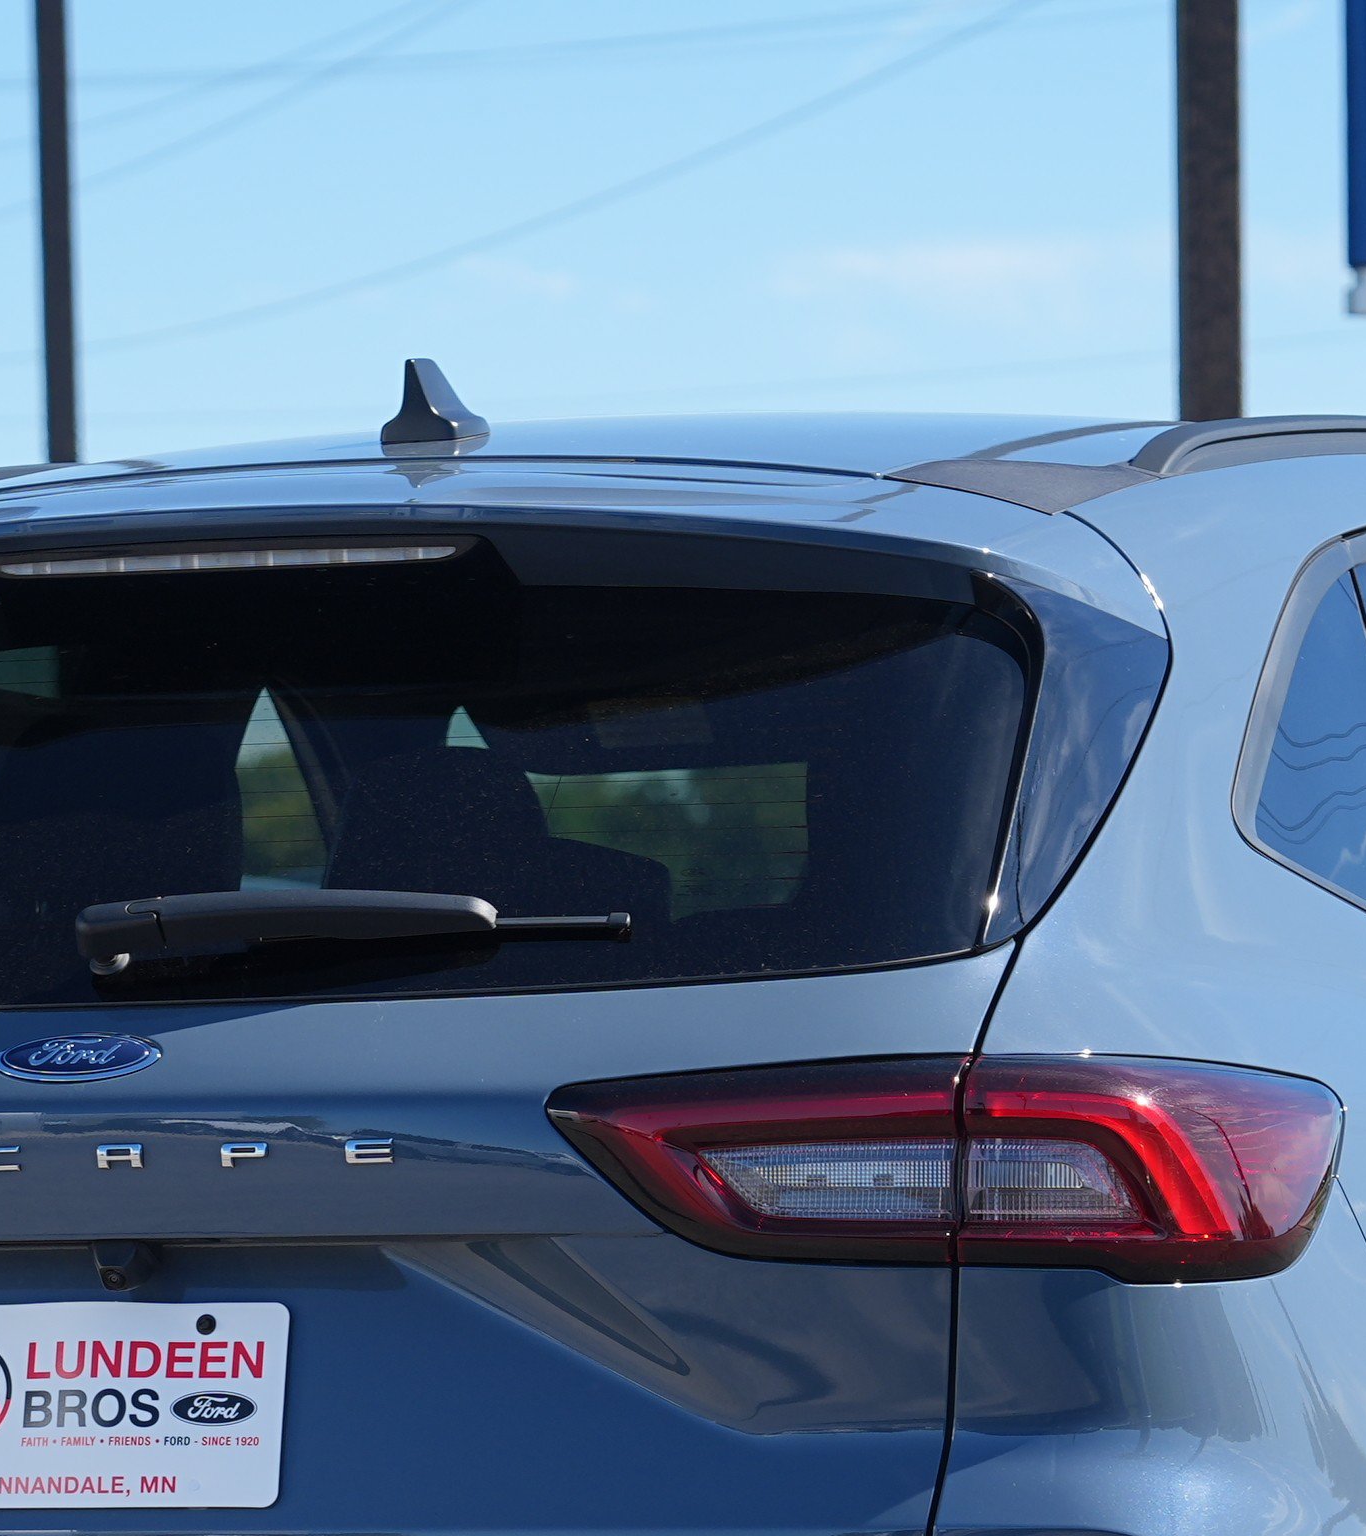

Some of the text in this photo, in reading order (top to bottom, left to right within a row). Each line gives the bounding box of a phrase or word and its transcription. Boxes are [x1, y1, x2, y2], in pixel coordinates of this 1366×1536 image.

[28, 1039, 122, 1066] Ford
[26, 1340, 265, 1379] LUNDEEN
[21, 1388, 160, 1429] BROS
[187, 1395, 241, 1419] Ford
[20, 1436, 260, 1447] FAITH FAMILY FRIENDS FORD SINCE 1920
[140, 1475, 177, 1494] MN
